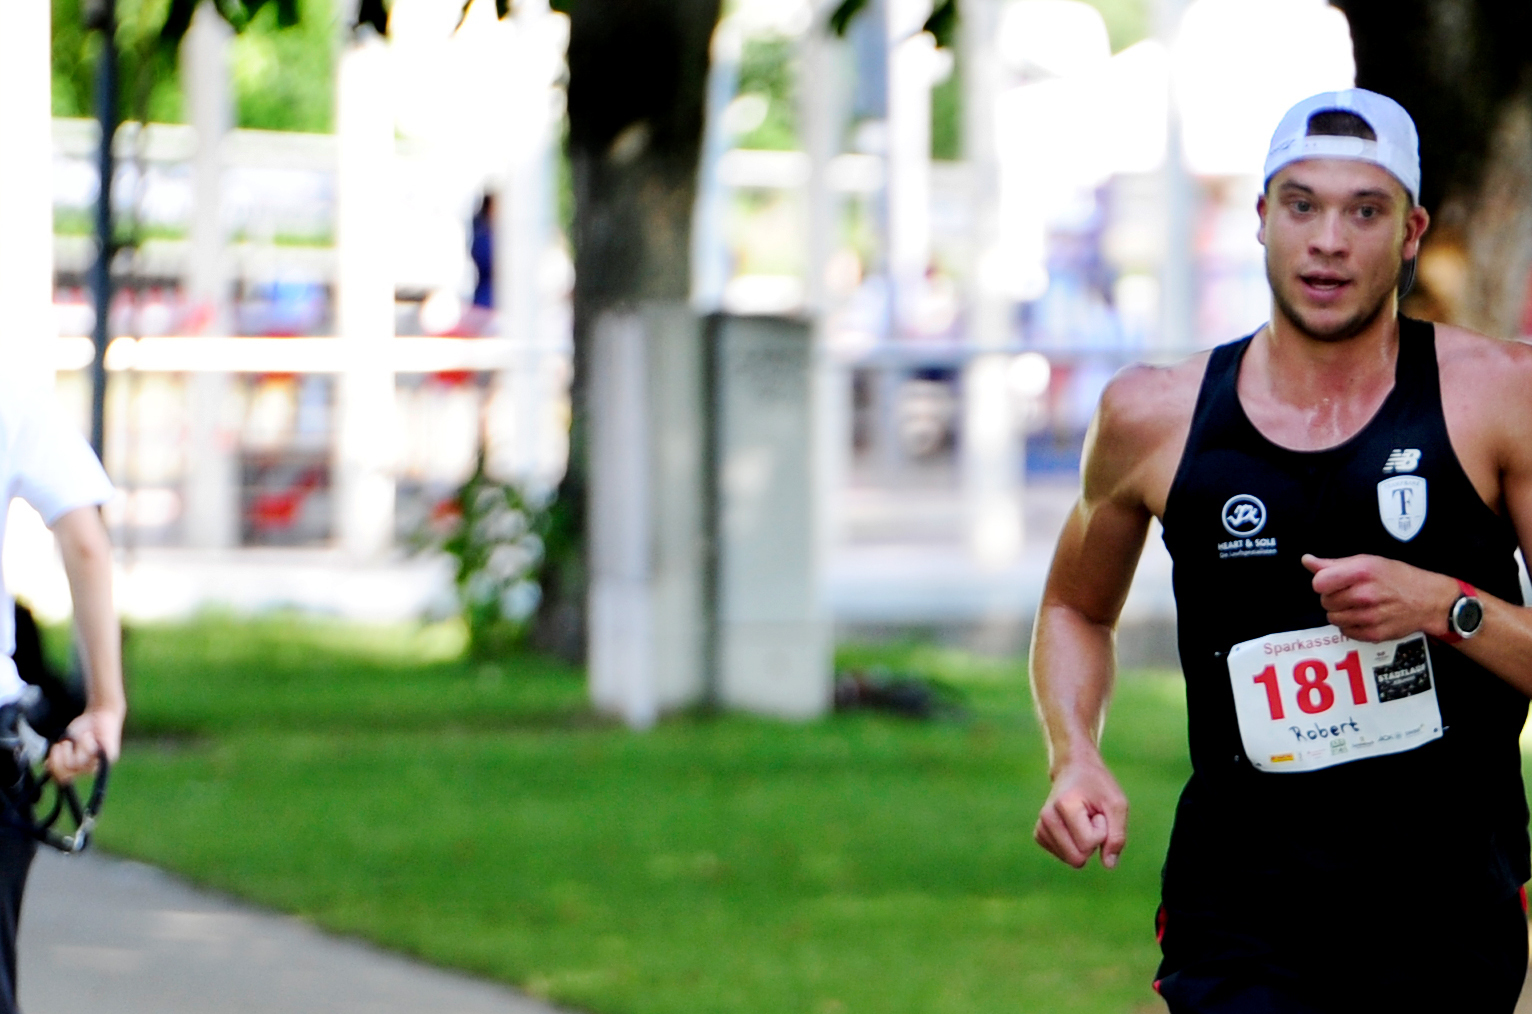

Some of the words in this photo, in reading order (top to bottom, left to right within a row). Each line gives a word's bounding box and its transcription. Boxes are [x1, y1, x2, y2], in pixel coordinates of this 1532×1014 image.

[1217, 539, 1243, 551] HEART
[1245, 538, 1254, 548] &
[1254, 537, 1277, 547] SOLE
[1252, 649, 1369, 721] 181
[1288, 716, 1361, 743] Robert
